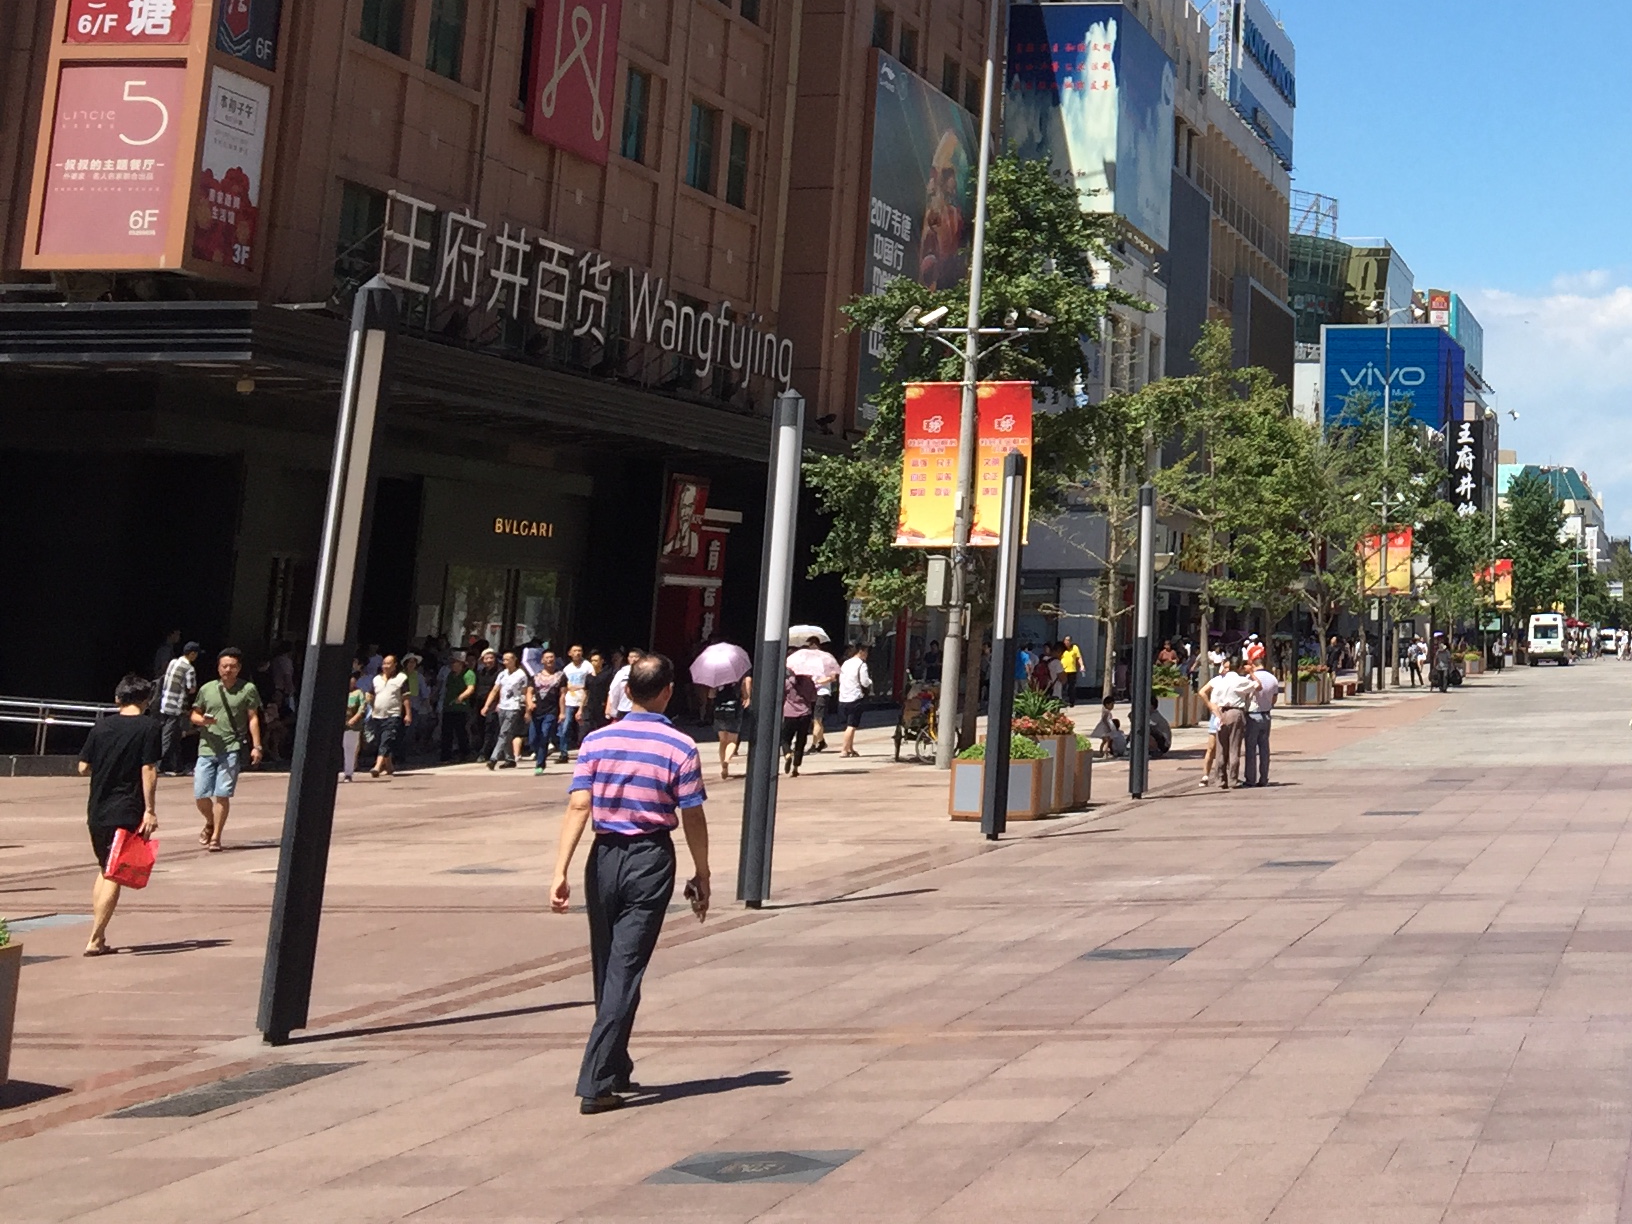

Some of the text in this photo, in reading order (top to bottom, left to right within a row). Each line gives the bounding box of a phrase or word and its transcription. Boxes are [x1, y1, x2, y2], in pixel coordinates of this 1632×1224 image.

[77, 14, 118, 36] 6/F
[255, 36, 273, 61] 6F
[119, 80, 169, 146] 5
[64, 158, 156, 171] 叔叔的主题餐厅
[128, 209, 160, 230] 6F
[231, 243, 251, 265] 3F
[873, 233, 905, 272] 中国行
[380, 188, 795, 391] 王府井百货 Wangfujing
[1340, 361, 1426, 386] vivo
[494, 517, 553, 538] BVLGARI
